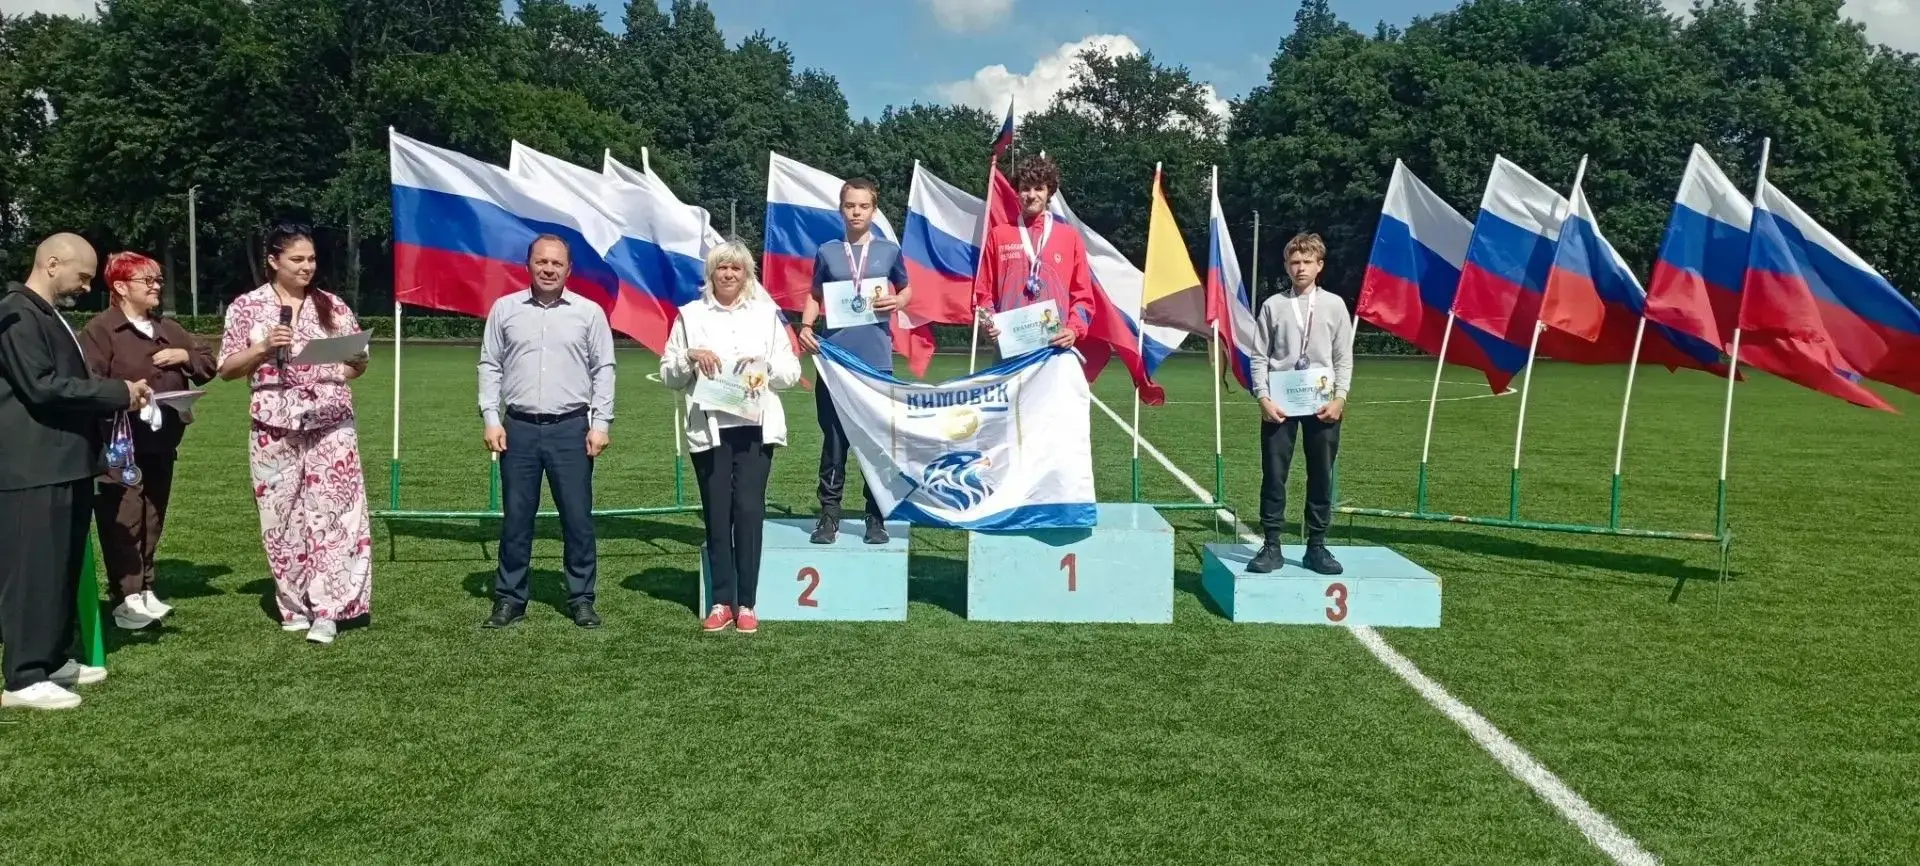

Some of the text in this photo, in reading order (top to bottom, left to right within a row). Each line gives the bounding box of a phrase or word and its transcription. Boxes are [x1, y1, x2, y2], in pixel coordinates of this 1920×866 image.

[906, 382, 1009, 410] КИМОВСК
[797, 566, 820, 607] 2
[1060, 553, 1076, 592] 1
[1325, 583, 1347, 622] 3
